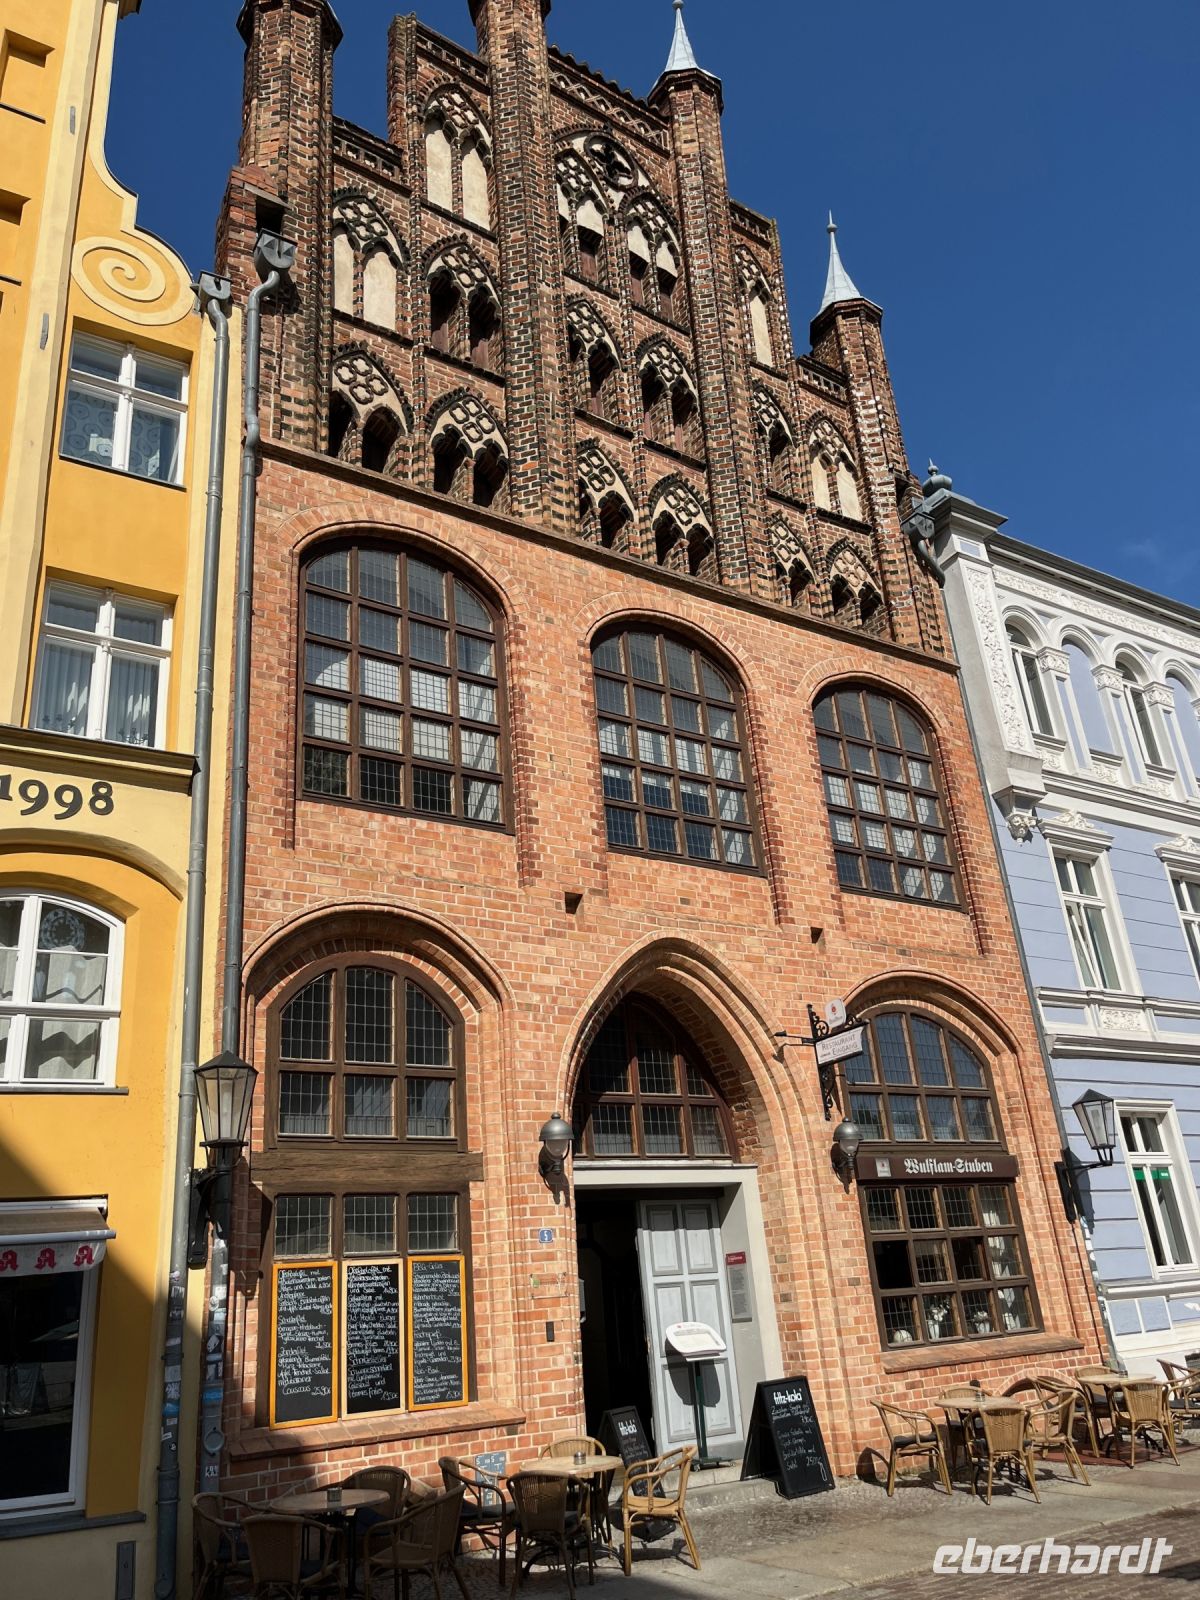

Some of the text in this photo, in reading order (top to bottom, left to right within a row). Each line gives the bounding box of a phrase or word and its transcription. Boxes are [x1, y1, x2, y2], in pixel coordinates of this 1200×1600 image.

[0, 774, 114, 820] 1998
[821, 1033, 857, 1051] RESTAURANT
[832, 1041, 858, 1056] EINGANG
[772, 1388, 803, 1405] fritz-kola
